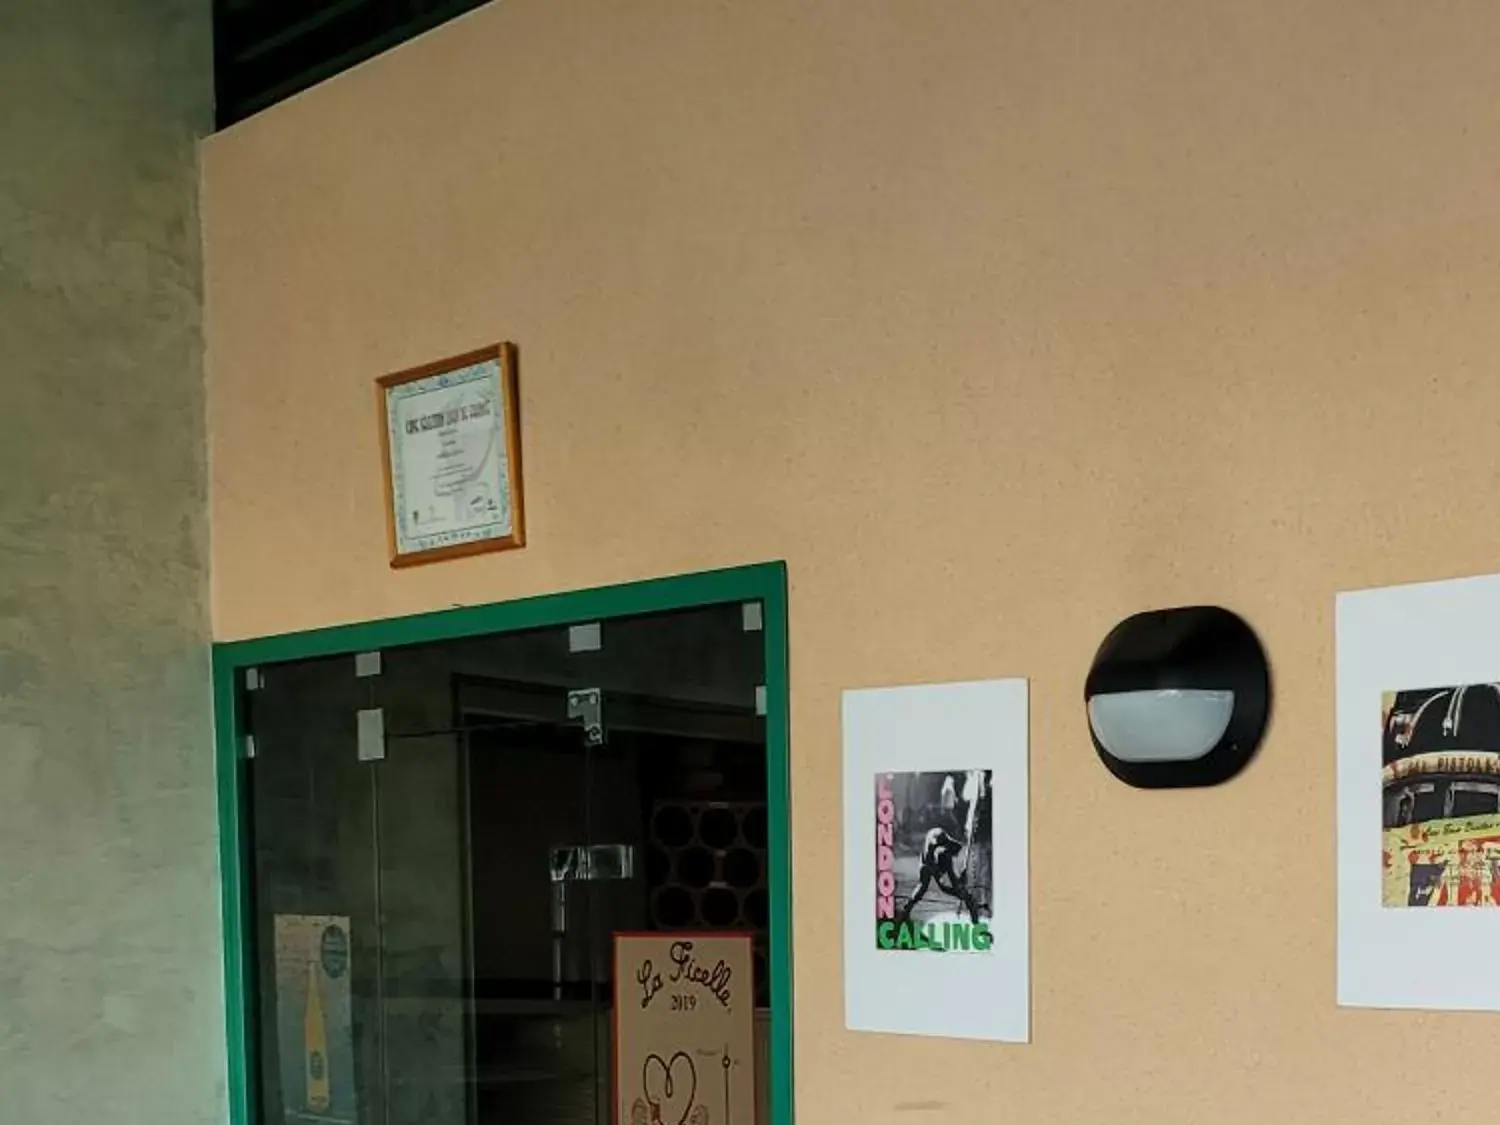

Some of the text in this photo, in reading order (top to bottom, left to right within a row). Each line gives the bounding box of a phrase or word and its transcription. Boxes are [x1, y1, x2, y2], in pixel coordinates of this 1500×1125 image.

[877, 775, 895, 919] LONDON
[878, 920, 992, 949] CALLING
[637, 941, 732, 1009] La Ficelle
